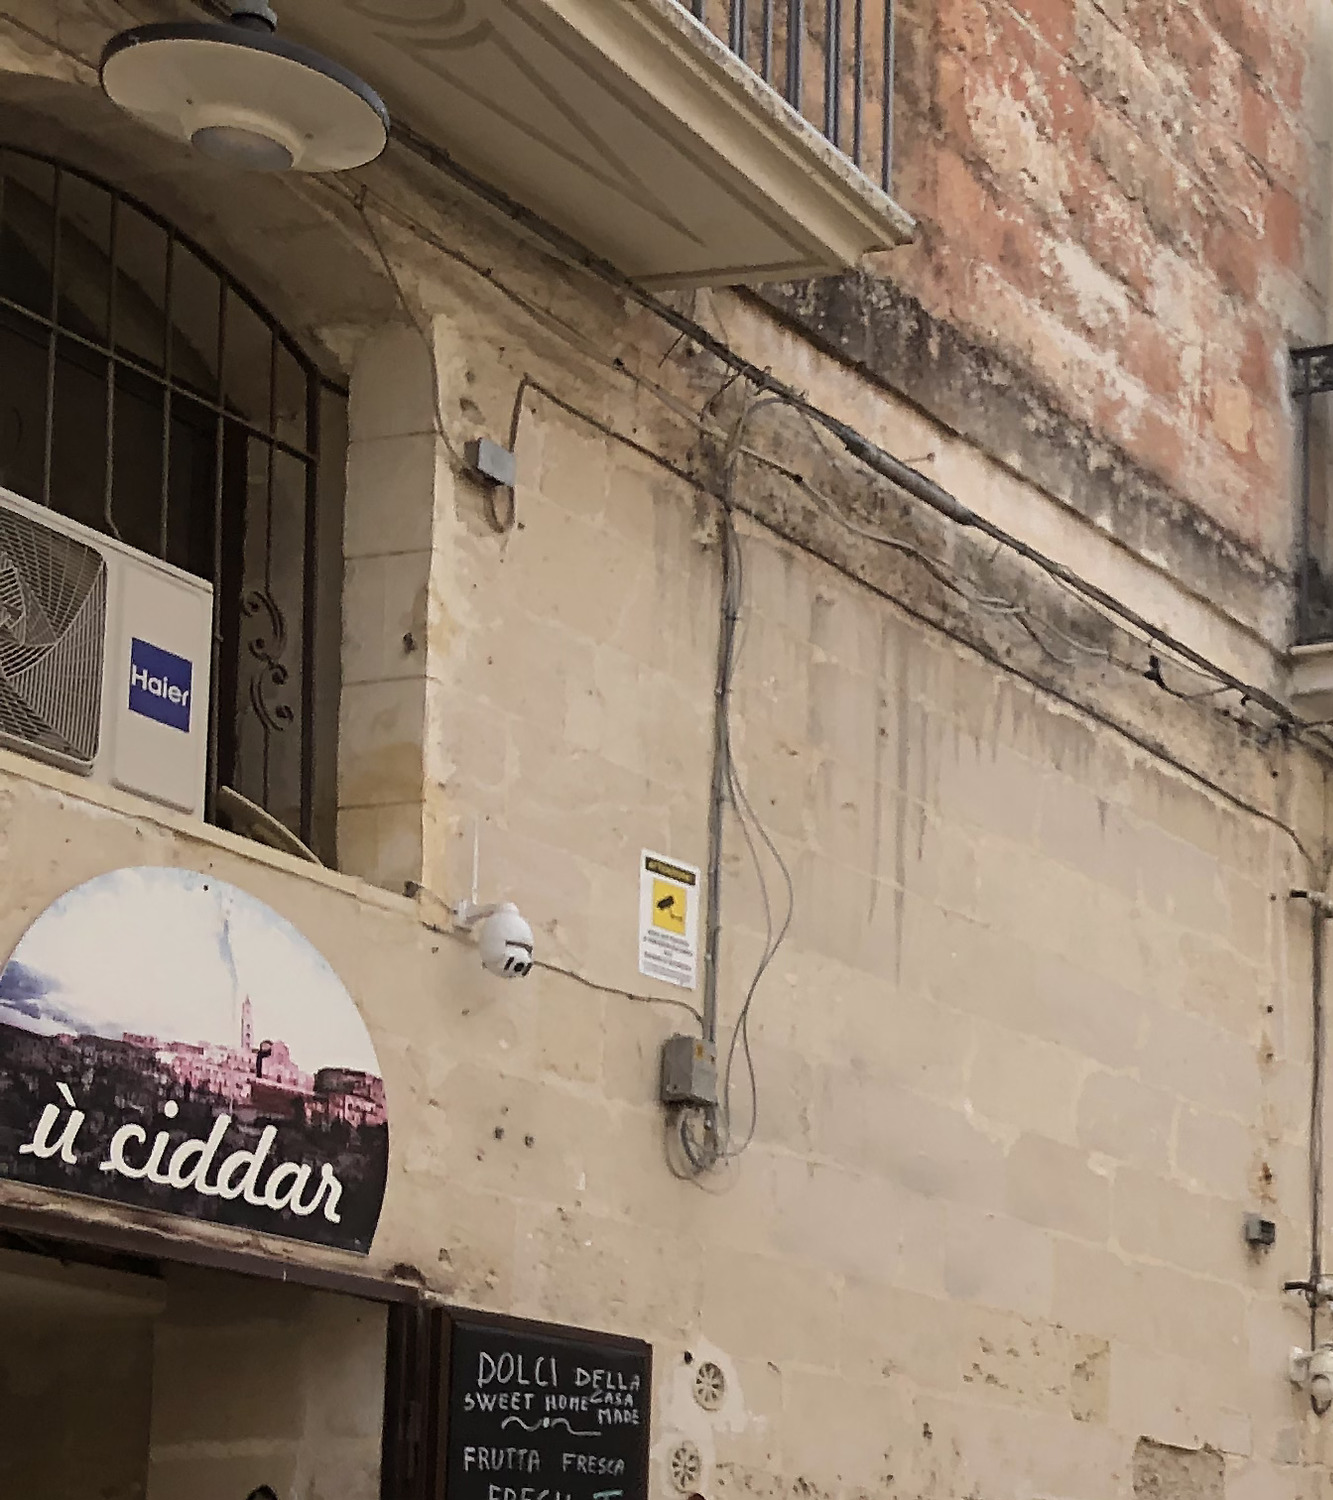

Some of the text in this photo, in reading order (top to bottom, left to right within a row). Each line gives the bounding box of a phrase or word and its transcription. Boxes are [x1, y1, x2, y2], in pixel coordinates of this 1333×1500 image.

[131, 663, 189, 706] Haier
[99, 1099, 344, 1225] ciddar
[477, 1351, 641, 1391] DOLCI DELLA
[464, 1391, 590, 1412] SWEET HOME
[589, 1389, 634, 1408] CASA
[597, 1408, 640, 1425] MADE
[463, 1446, 626, 1476] FRUTTA FRESCA
